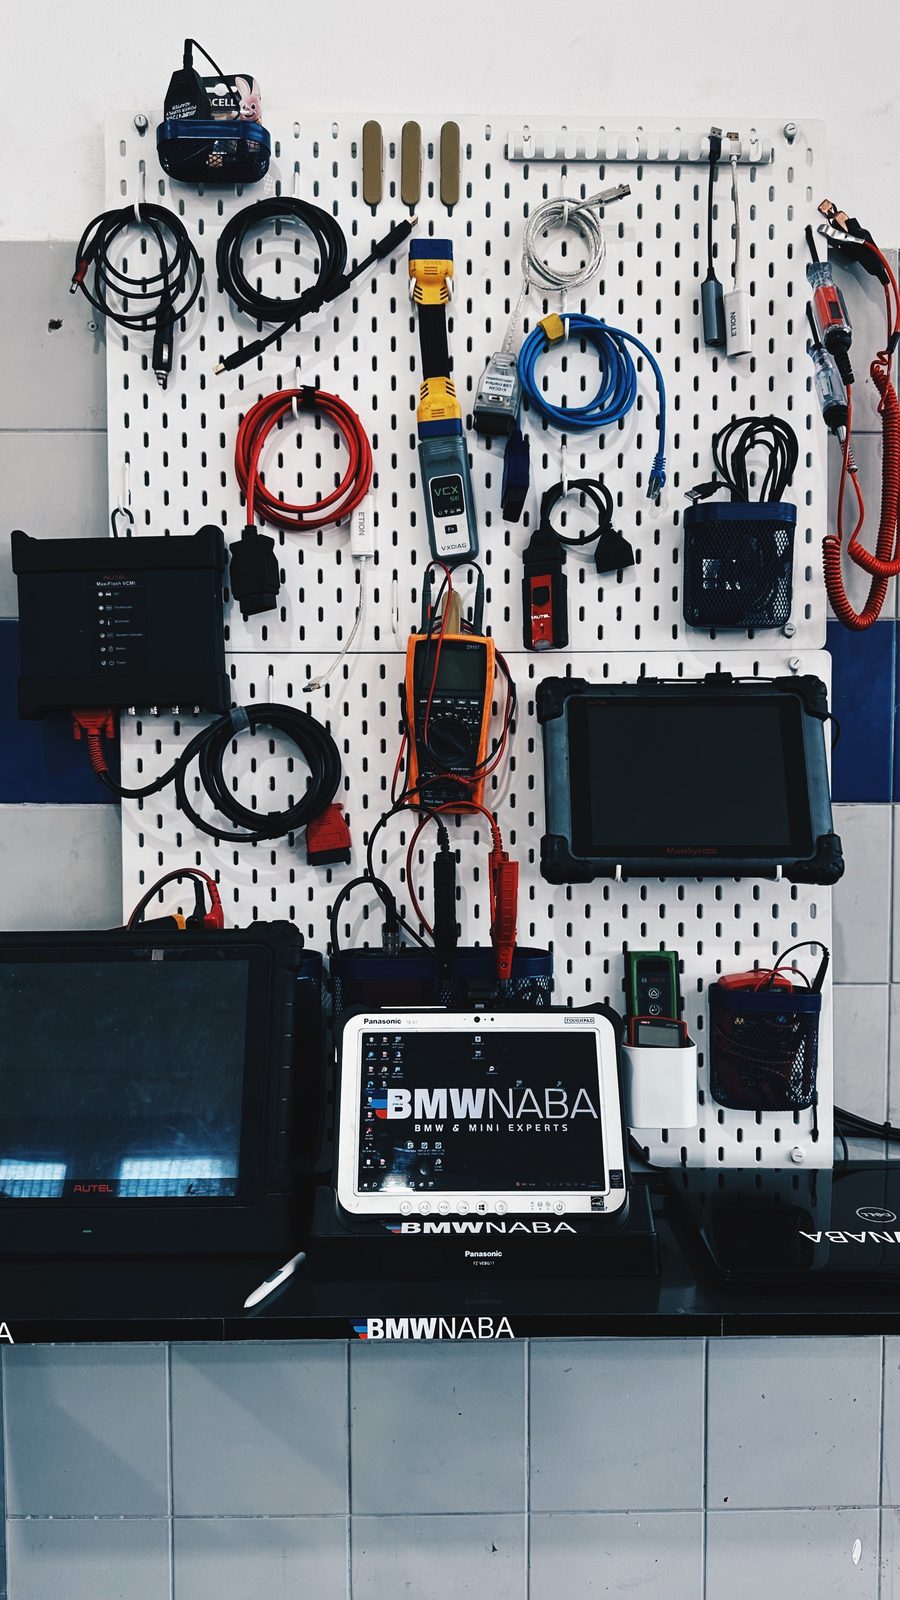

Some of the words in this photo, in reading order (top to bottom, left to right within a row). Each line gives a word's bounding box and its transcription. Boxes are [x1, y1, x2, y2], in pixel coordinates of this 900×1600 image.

[172, 102, 191, 111] ADAPTER
[181, 105, 197, 114] POWER
[434, 485, 459, 496] VCX
[441, 542, 467, 551] VXDIAG
[387, 1088, 599, 1119] BMWNABA
[414, 1124, 444, 1132] BMW
[452, 1124, 460, 1132] &
[468, 1124, 500, 1132] MINI
[508, 1123, 569, 1132] EXPERTS
[73, 1184, 113, 1193] AUTEL
[401, 1221, 578, 1234] BMWNABA
[799, 1230, 900, 1243] NABA
[464, 1250, 503, 1258] Panasonic
[366, 1316, 516, 1340] BMWNABA
